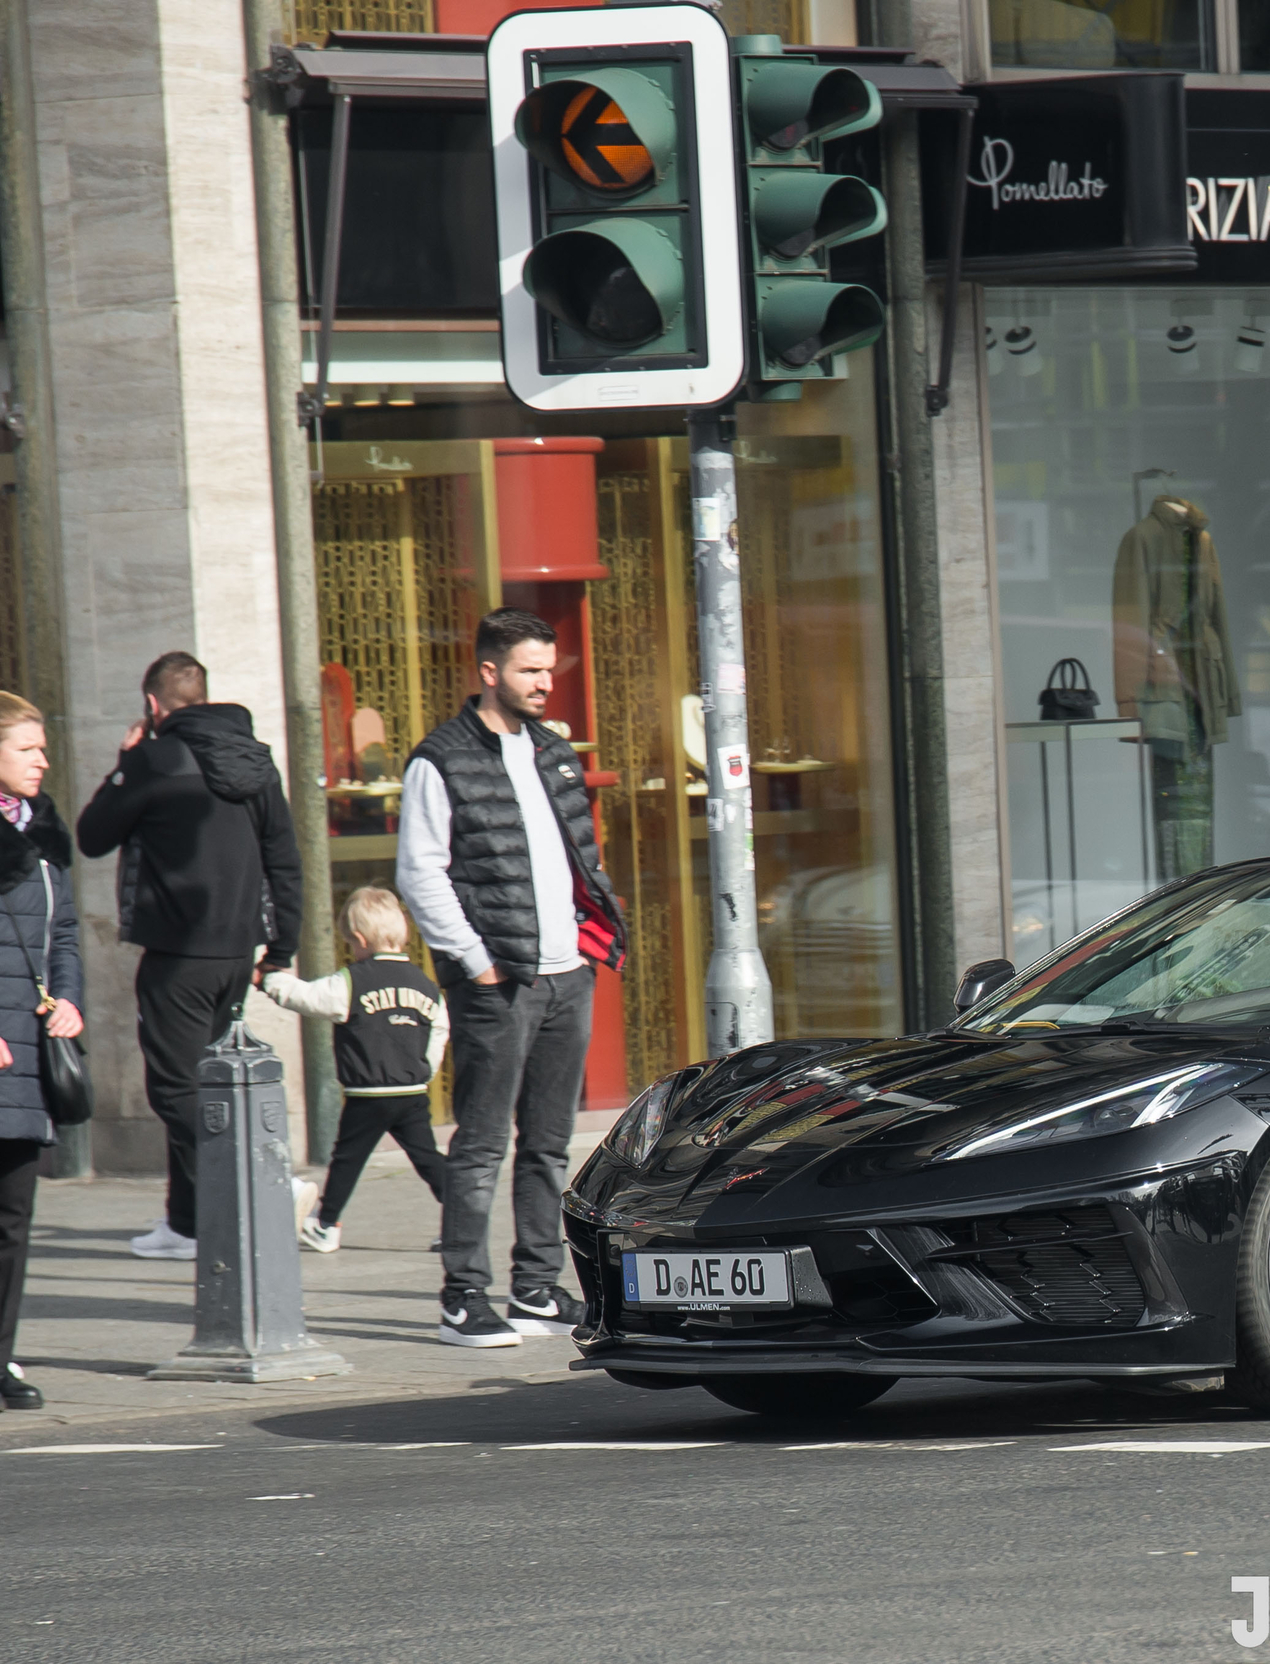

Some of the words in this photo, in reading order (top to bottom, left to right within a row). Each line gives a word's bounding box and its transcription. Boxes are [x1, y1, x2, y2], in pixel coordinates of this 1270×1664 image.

[966, 135, 1108, 210] Pomellato
[653, 1259, 671, 1296] D
[690, 1259, 724, 1296] AE
[730, 1259, 765, 1296] 60
